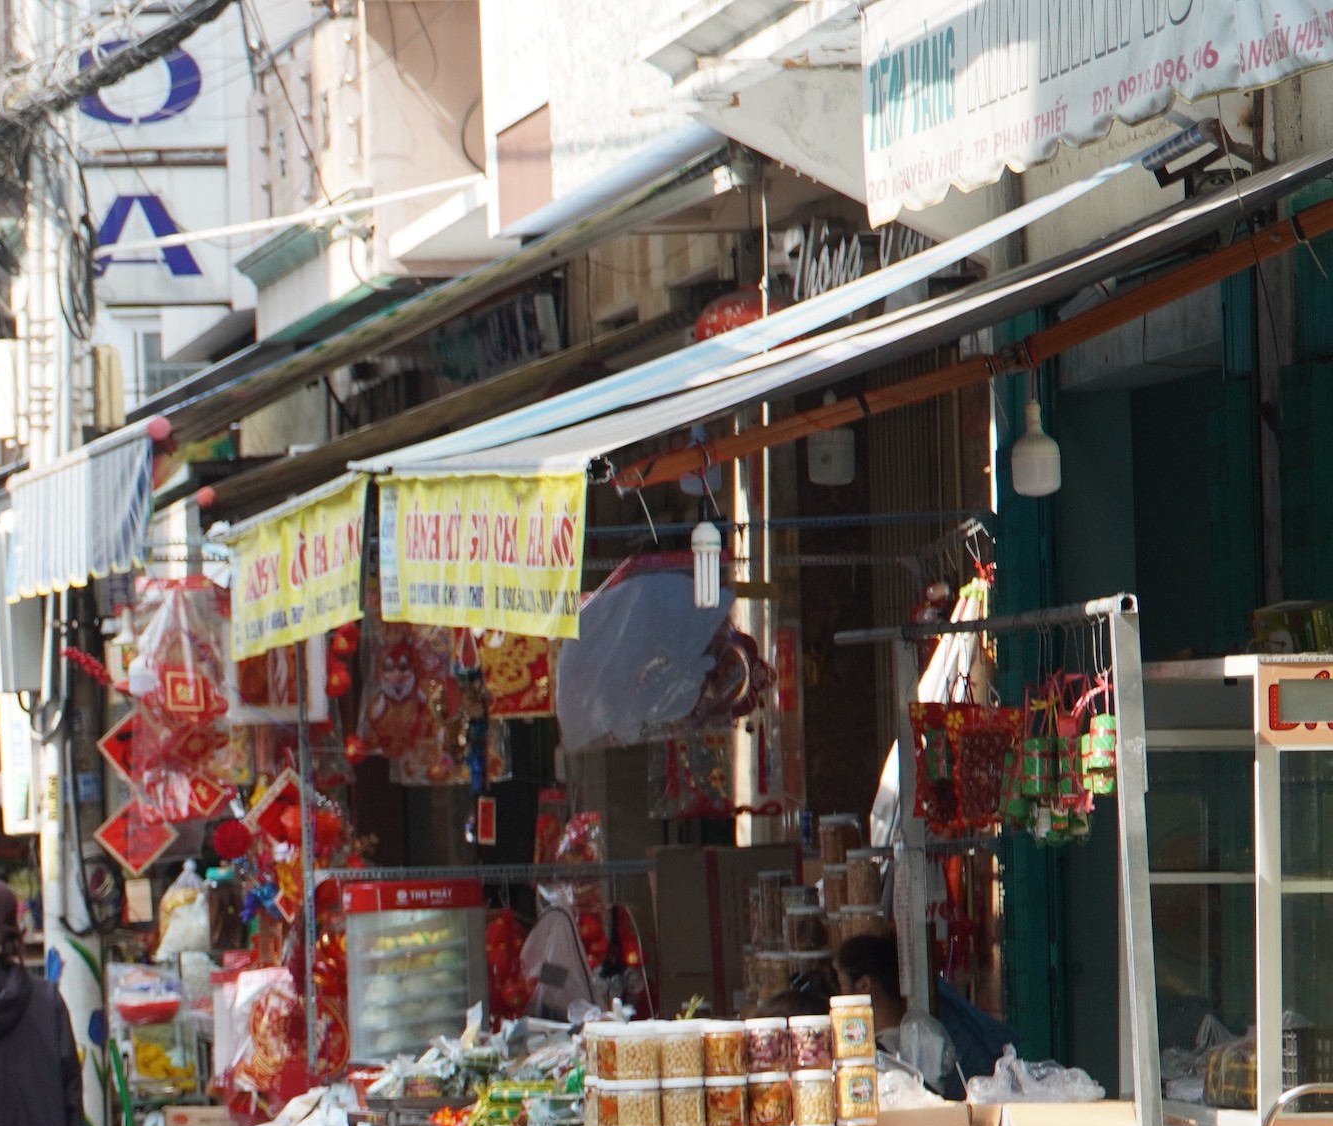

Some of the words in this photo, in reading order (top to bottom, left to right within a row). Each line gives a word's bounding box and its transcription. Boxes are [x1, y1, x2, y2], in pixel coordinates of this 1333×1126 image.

[910, 19, 956, 136] VÀNG
[993, 121, 1030, 158] PHAN
[1033, 94, 1069, 140] THIẾT
